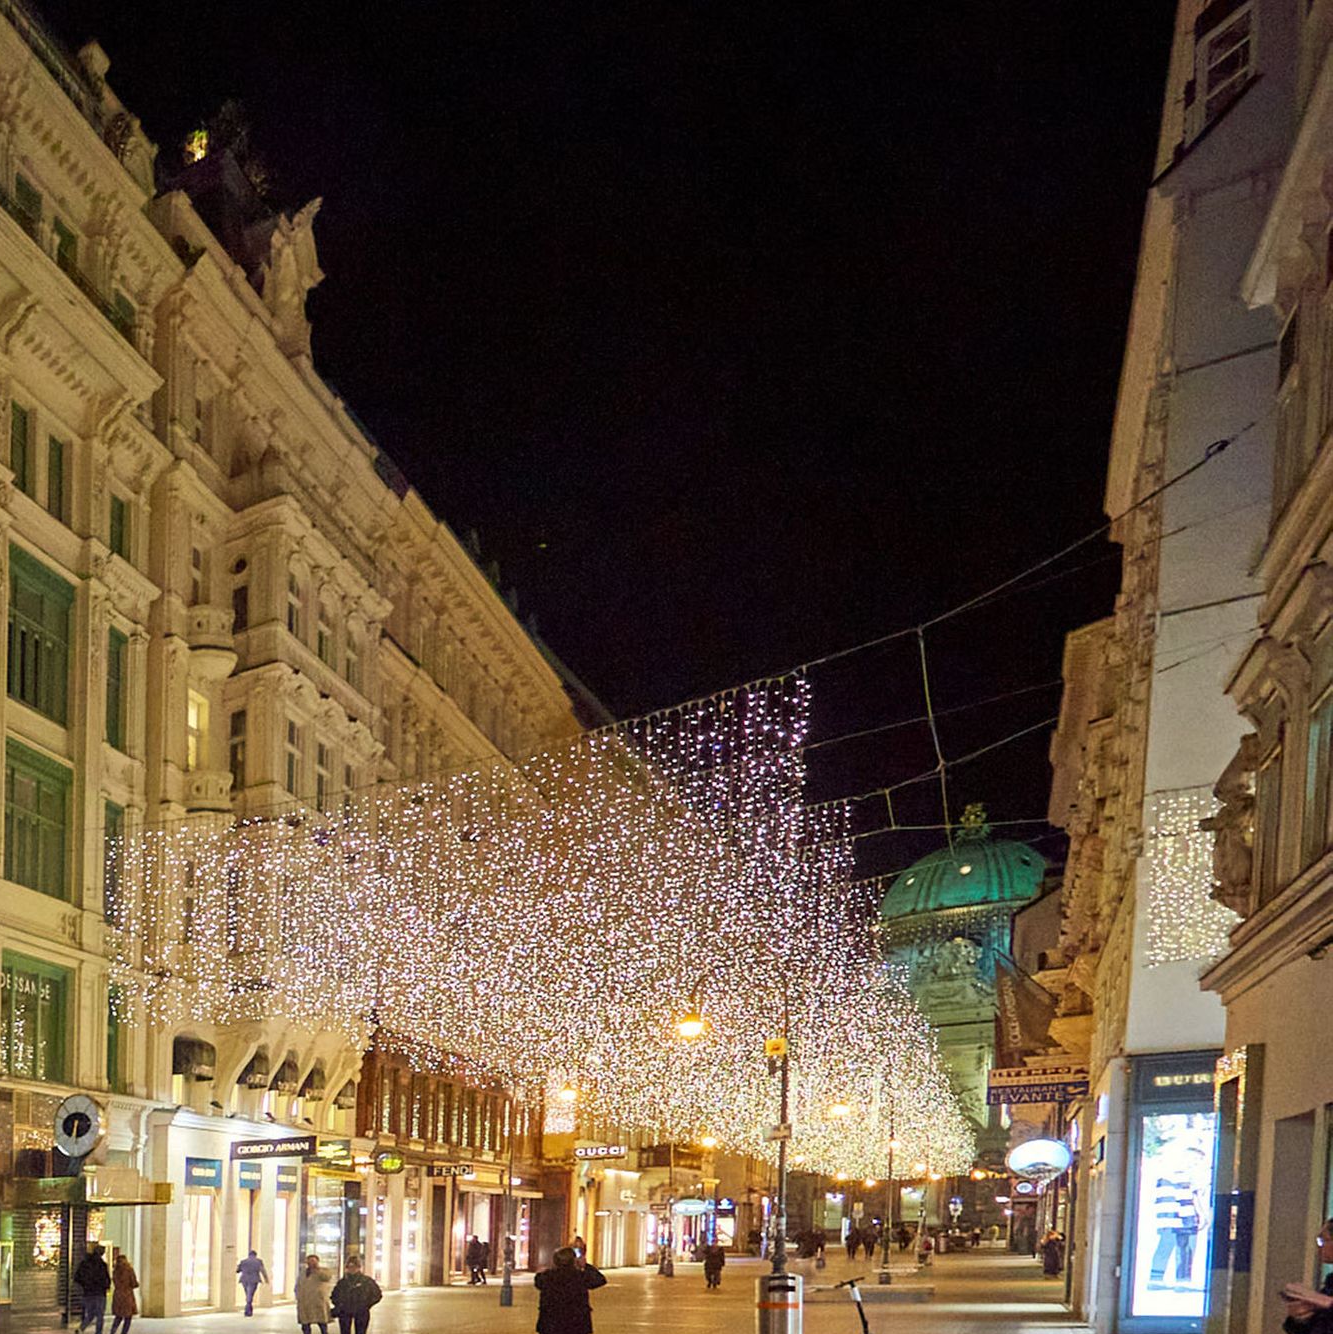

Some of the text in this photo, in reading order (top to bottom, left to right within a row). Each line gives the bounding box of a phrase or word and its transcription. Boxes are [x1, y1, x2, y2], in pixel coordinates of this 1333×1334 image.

[990, 1092, 1064, 1104] LEVANTE
[275, 1141, 310, 1153] ARMANI
[575, 1145, 627, 1157] GUCCI
[433, 1164, 474, 1177] FENDI
